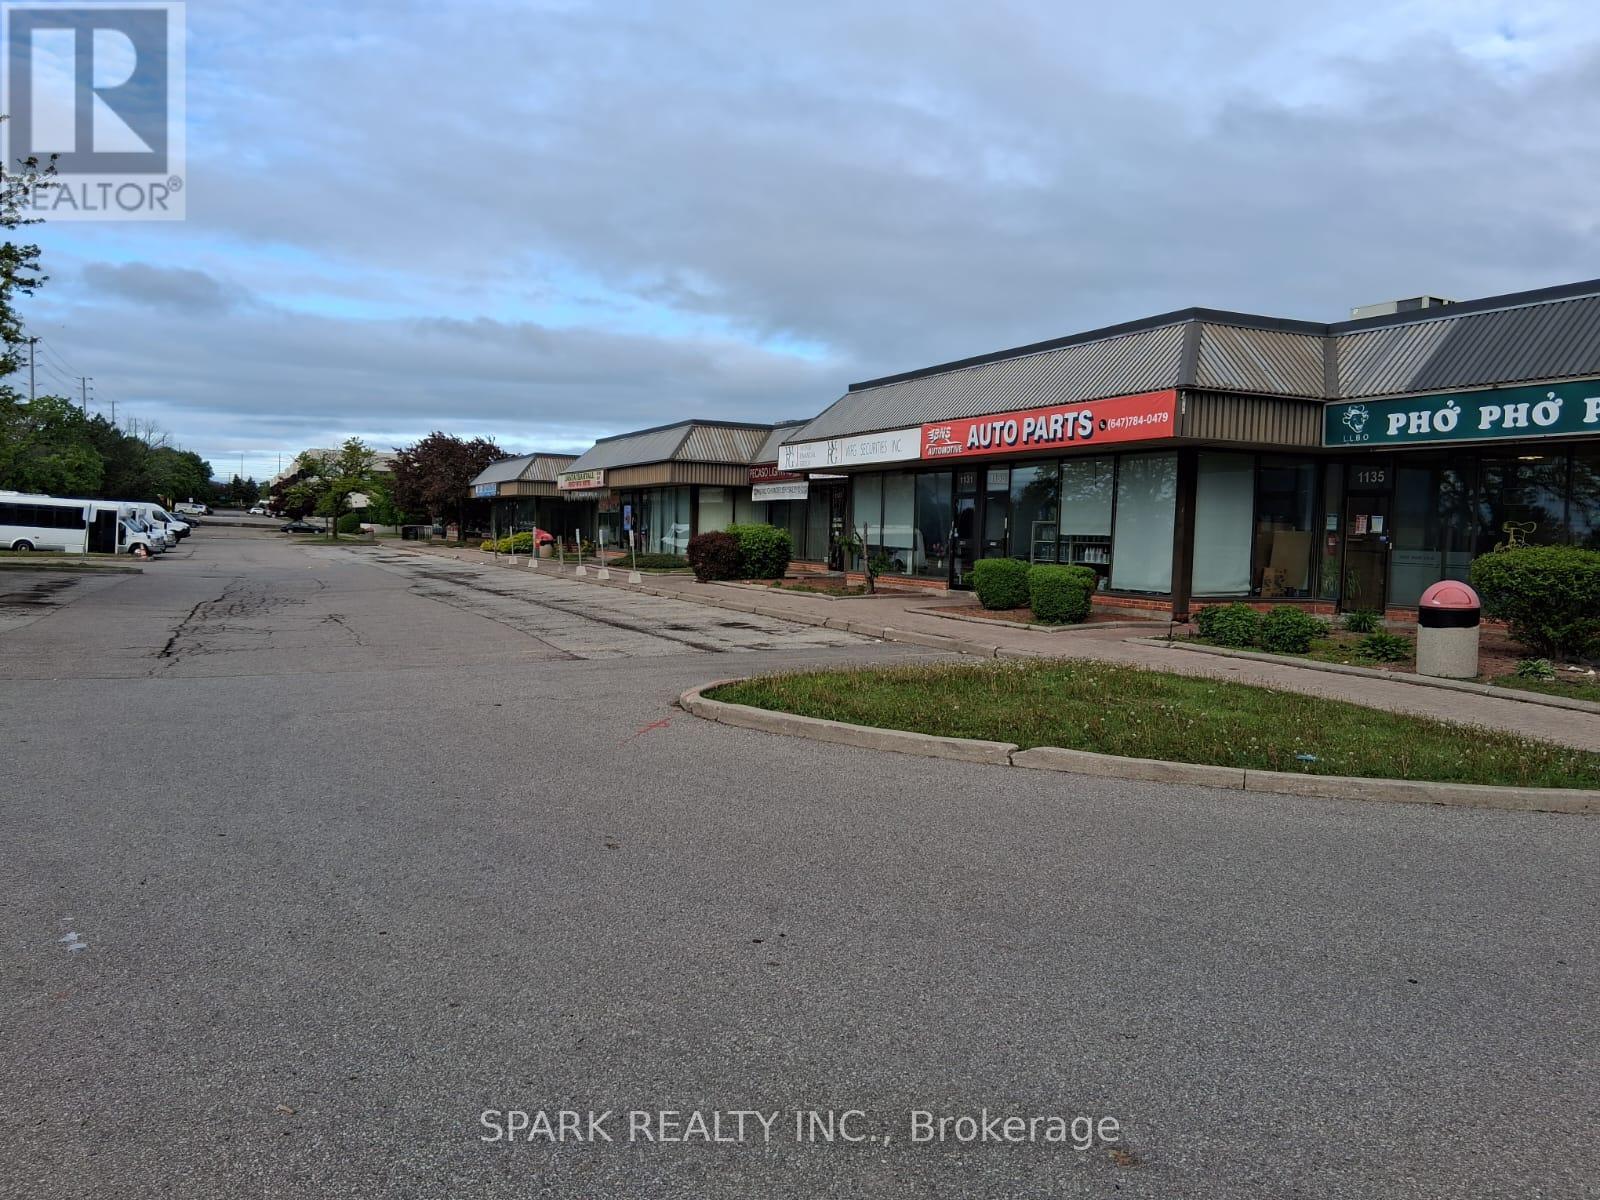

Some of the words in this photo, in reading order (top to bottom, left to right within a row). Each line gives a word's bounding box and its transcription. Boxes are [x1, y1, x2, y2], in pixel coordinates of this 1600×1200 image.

[1386, 400, 1462, 436] PHỞ
[1477, 391, 1563, 430] PHỞ
[967, 420, 1019, 448] AUTO
[1022, 410, 1094, 444] PARTS
[1107, 411, 1169, 431] (647)784-0479
[928, 444, 963, 456] AUTOMOTIVE
[1357, 471, 1385, 483] 1135
